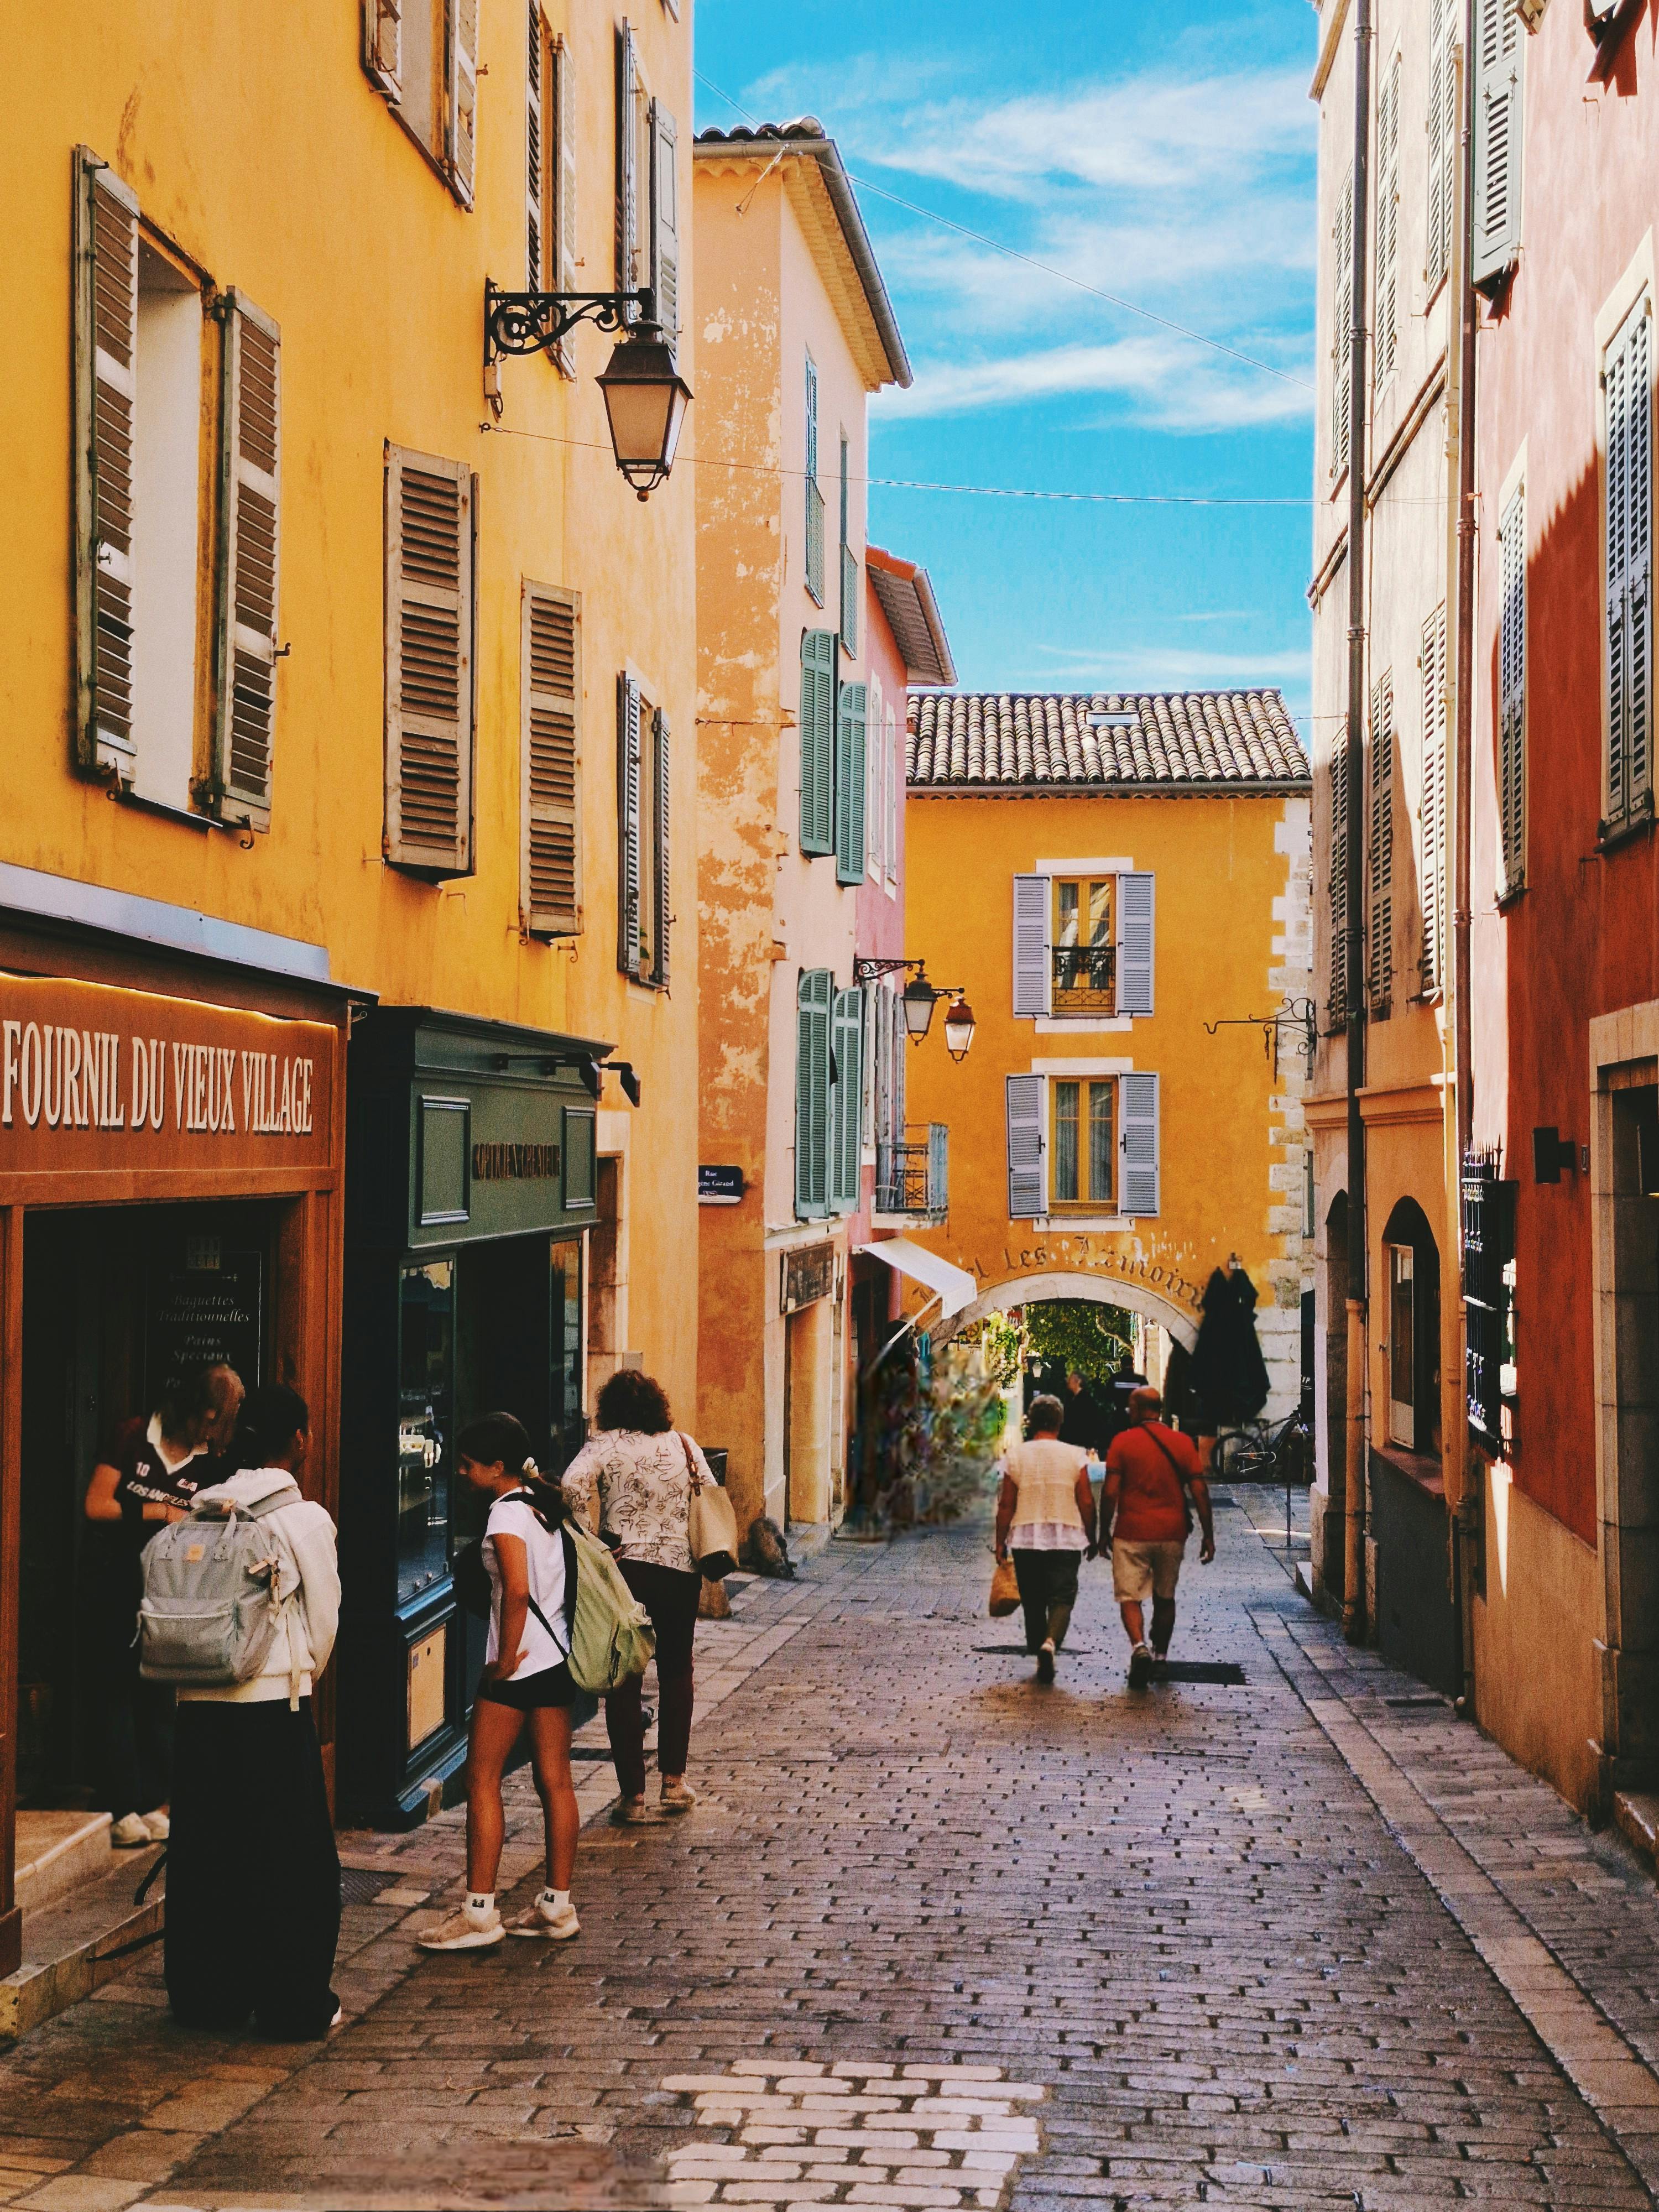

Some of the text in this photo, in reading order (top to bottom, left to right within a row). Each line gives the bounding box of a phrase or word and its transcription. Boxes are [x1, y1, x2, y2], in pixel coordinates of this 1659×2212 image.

[2, 1020, 314, 1133] FOURNIL DU VIEUX VILLAGE
[173, 1294, 235, 1308] Baguettes
[158, 1308, 250, 1322] Traditionnelles
[136, 1462, 150, 1477] 10
[127, 1481, 150, 1497] LOS
